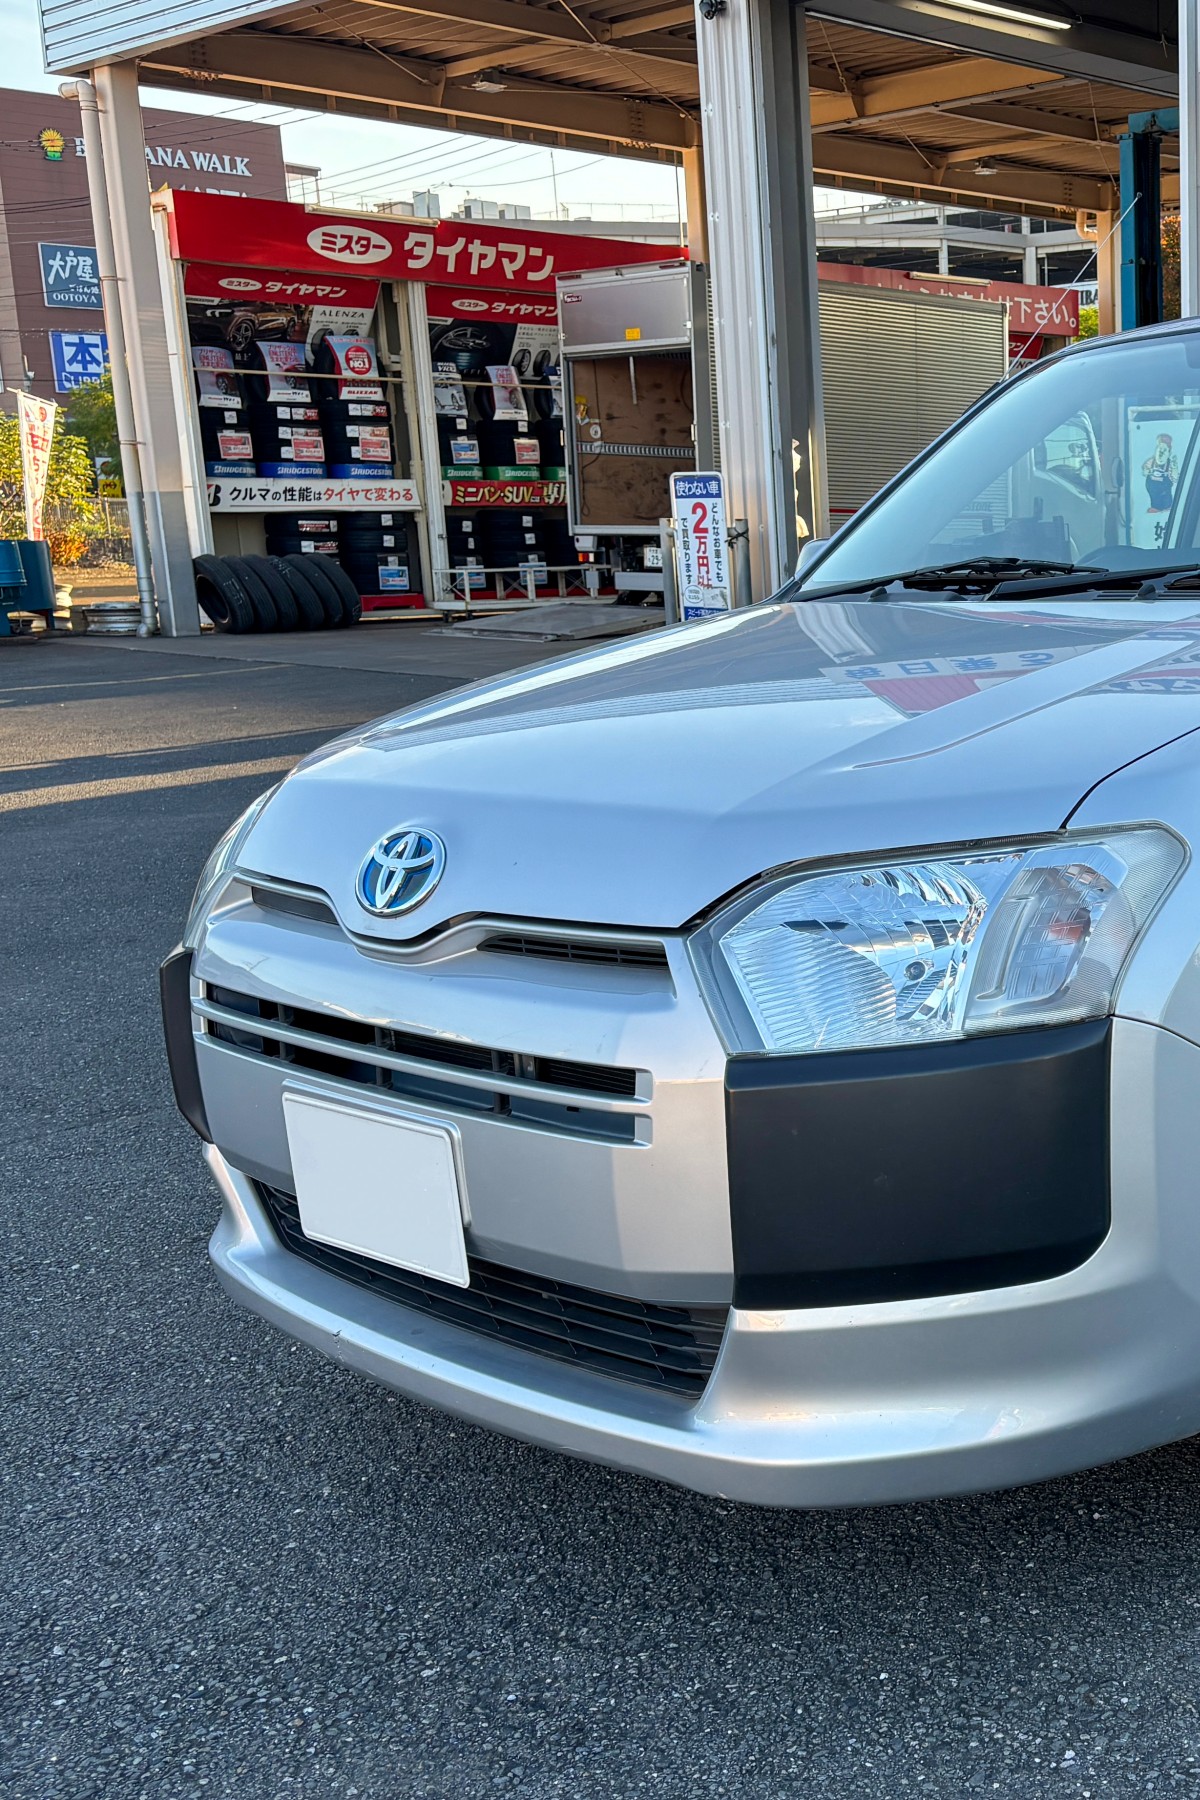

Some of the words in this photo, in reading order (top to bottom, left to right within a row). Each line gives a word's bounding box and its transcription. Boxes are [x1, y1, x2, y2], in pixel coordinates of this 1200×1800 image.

[191, 151, 252, 177] WALK
[321, 231, 386, 256] ミスター
[404, 232, 555, 281] タイヤマン
[47, 250, 99, 285] 大戸屋
[53, 292, 97, 304] OOTOYA
[226, 279, 256, 288] ミスター
[265, 281, 347, 298] タイヤマン
[320, 309, 365, 319] ALENZA
[491, 302, 558, 317] タイヤマン
[64, 336, 102, 371] 本
[229, 486, 414, 502] クルマの性能はタイヤで変わる
[676, 481, 719, 496] 使わない車
[681, 518, 693, 584] で買取ります
[712, 502, 723, 583] どんなお車でも
